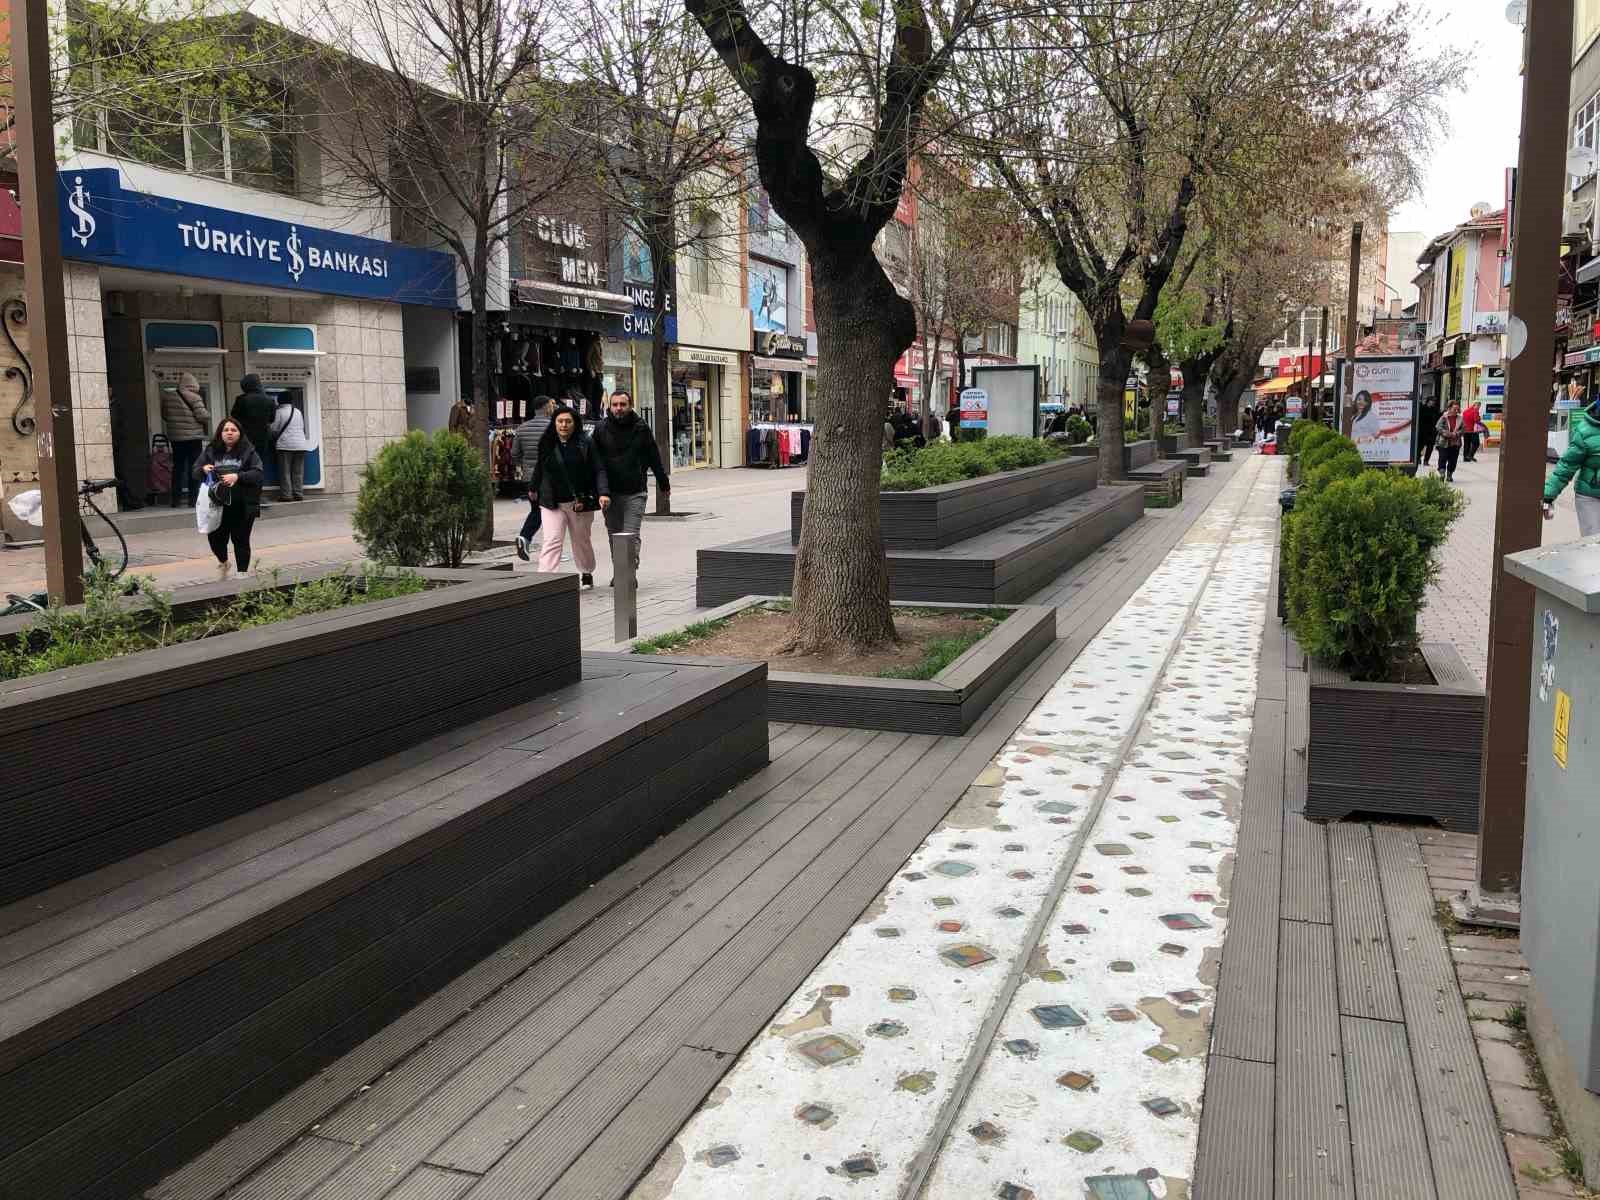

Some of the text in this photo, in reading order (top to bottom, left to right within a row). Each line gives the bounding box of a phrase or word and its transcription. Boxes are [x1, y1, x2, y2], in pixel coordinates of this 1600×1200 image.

[537, 215, 586, 250] CLUB
[178, 220, 282, 263] TÜRKİYE
[308, 247, 389, 279] BANKASI
[561, 256, 600, 286] MEN
[562, 295, 580, 309] CLUB
